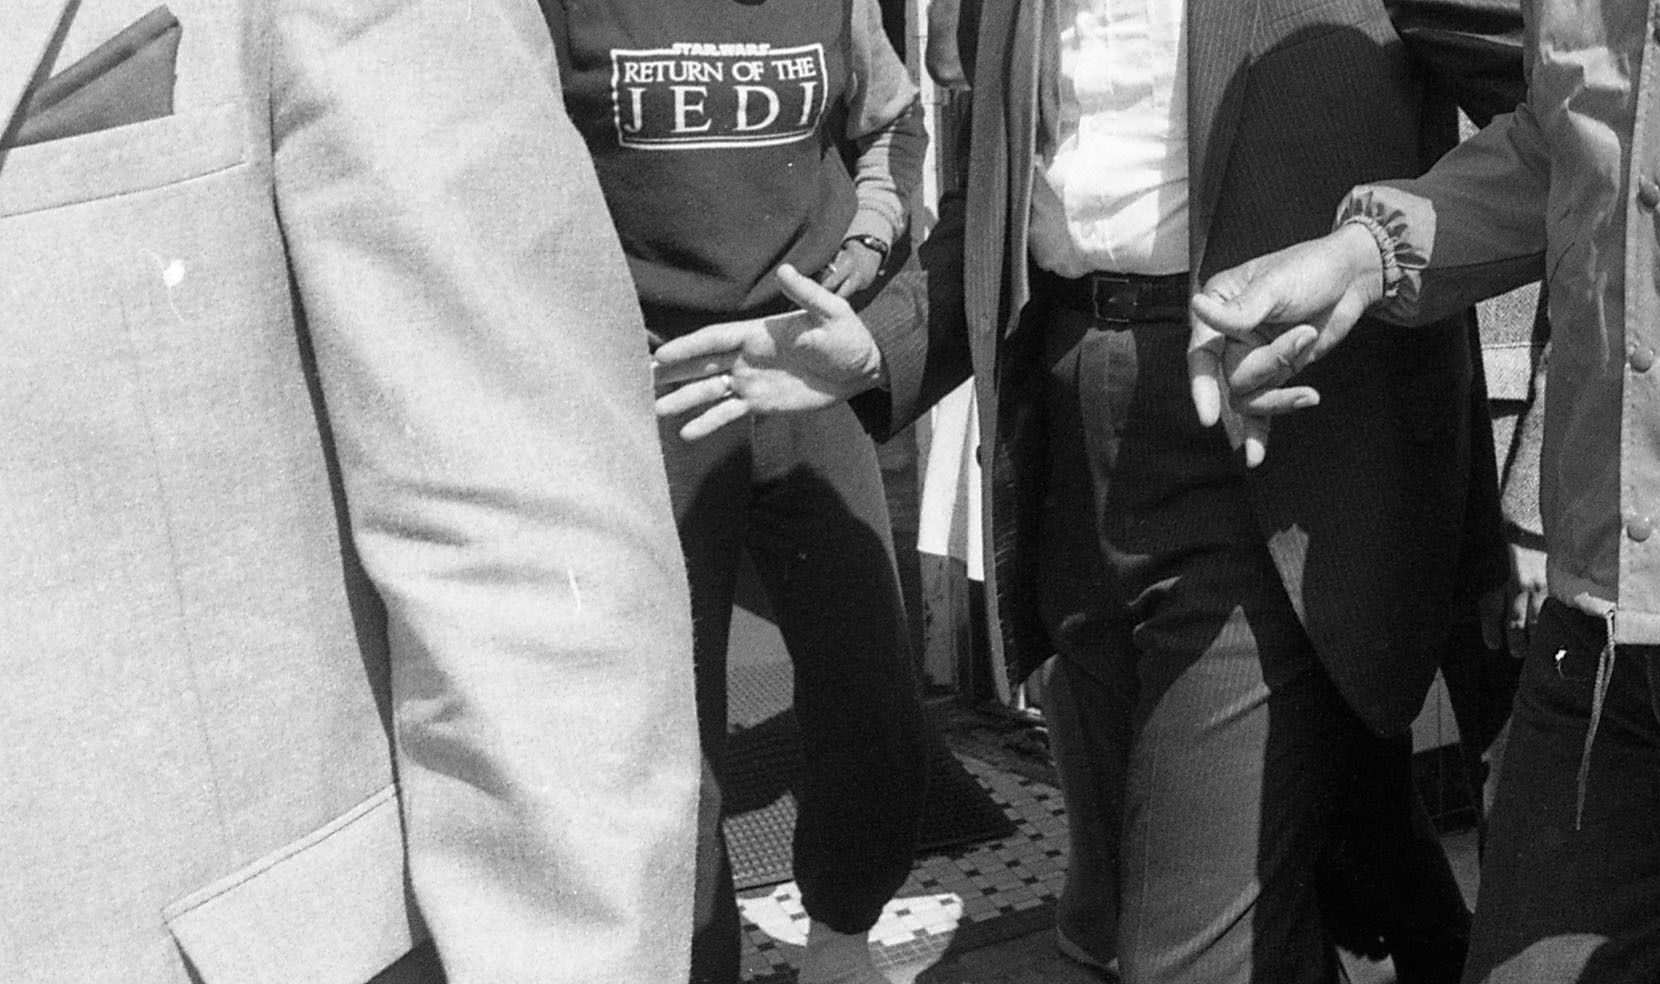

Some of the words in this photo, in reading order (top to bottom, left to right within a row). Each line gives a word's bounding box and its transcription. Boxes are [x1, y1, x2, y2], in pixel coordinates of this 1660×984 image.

[624, 61, 723, 83] RETURN
[732, 61, 764, 81] OF
[771, 57, 817, 80] THE
[624, 82, 818, 133] JEDI
